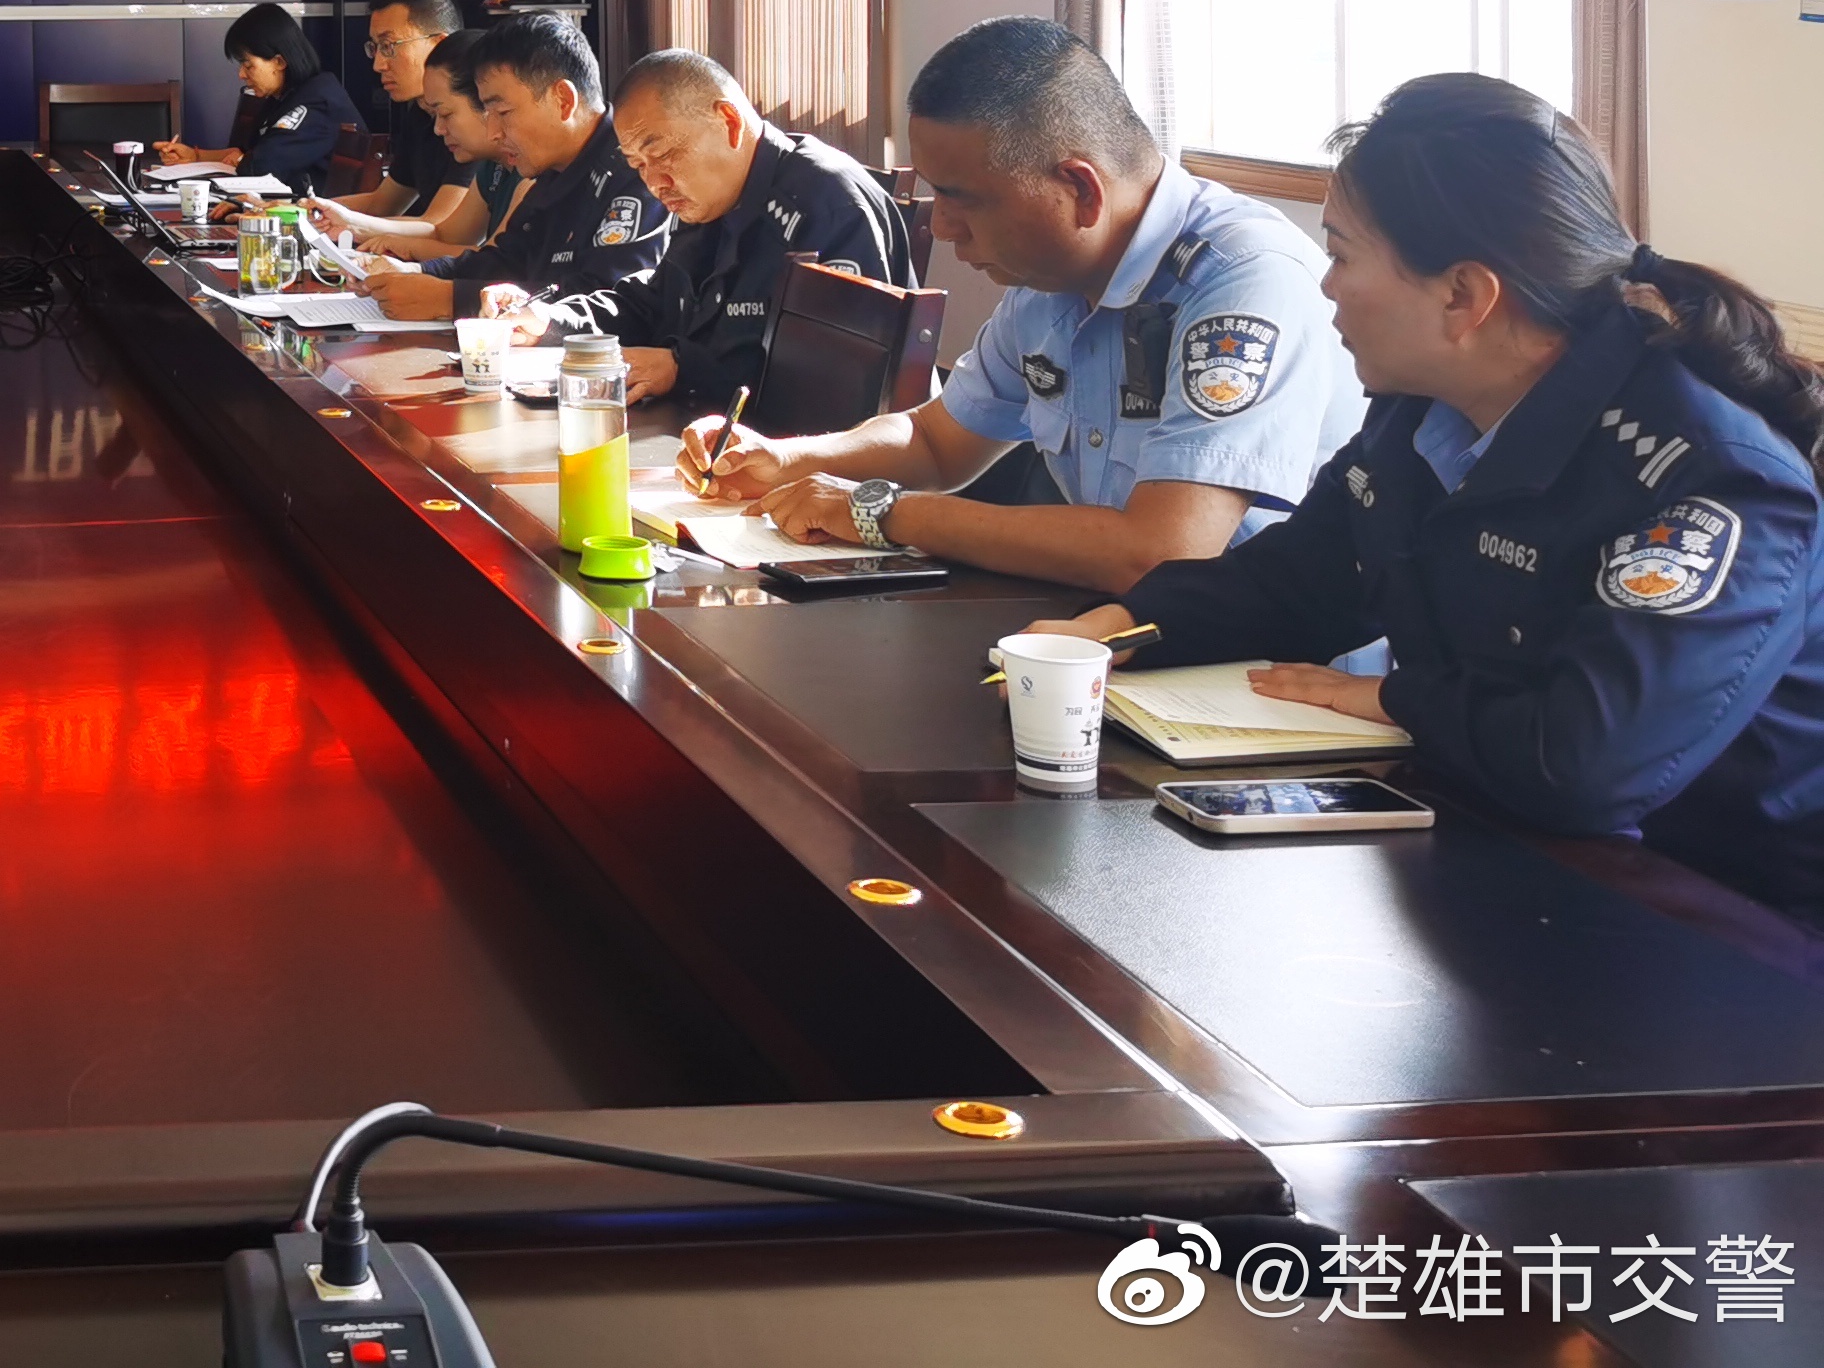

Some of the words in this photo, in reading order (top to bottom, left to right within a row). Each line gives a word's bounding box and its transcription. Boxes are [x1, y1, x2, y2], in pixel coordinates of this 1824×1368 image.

[727, 302, 764, 316] 004791
[1188, 318, 1274, 344] 中华人民共和国
[1479, 531, 1537, 572] 004962
